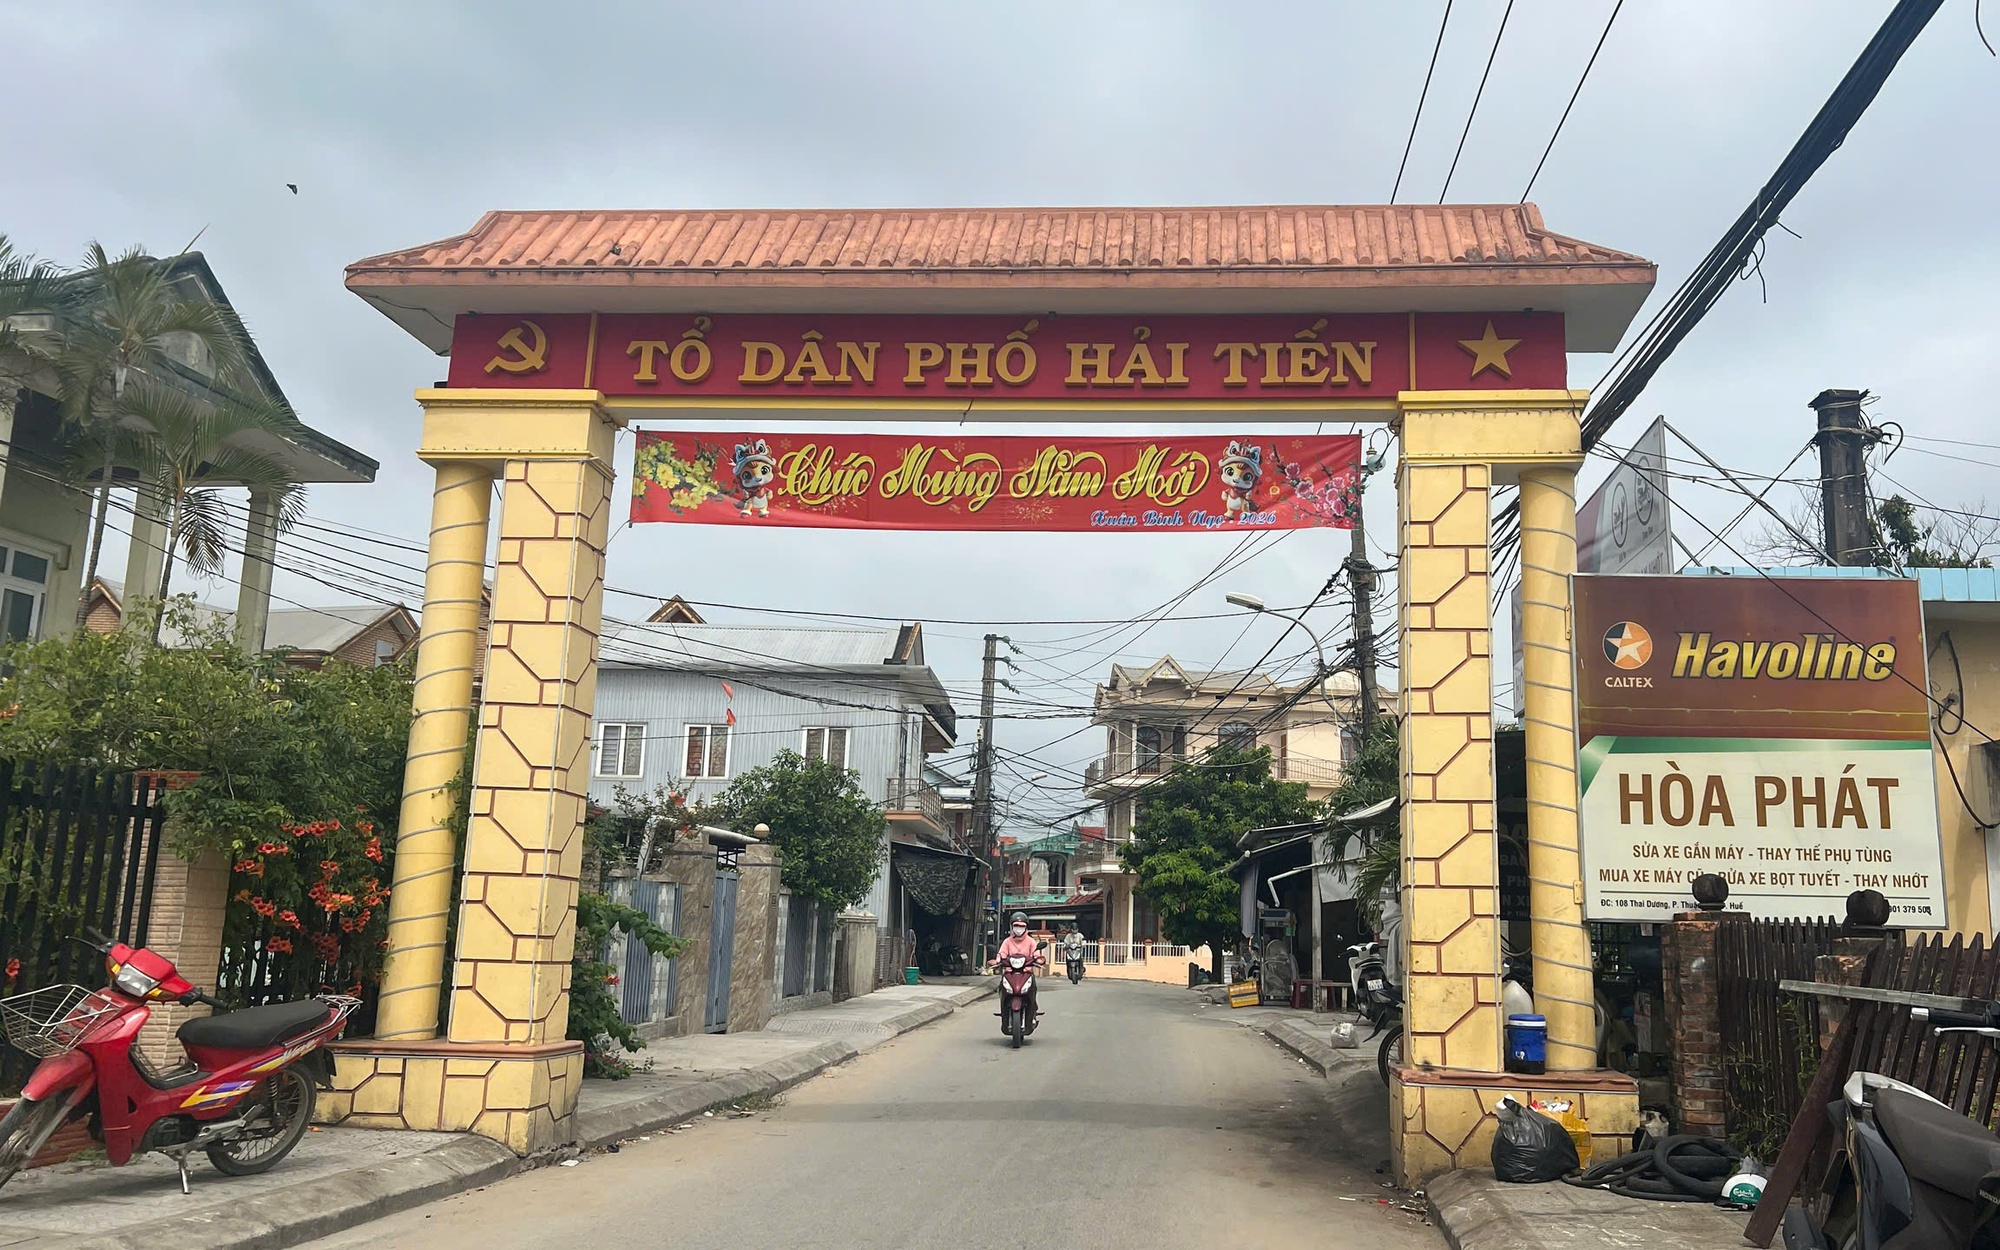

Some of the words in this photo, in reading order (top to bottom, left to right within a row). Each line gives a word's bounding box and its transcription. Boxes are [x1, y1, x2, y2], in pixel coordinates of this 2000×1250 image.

[626, 316, 711, 383] TỔ
[738, 330, 881, 384] DÂN
[903, 319, 1038, 386] PHỐ
[1064, 326, 1190, 387] HẢI
[1213, 318, 1377, 387] TIẾN
[778, 443, 876, 505] Chúc
[880, 443, 1002, 512] Mừng
[1009, 444, 1107, 499] Năm
[1112, 444, 1210, 507] Mới
[1090, 510, 1138, 526] Xuân
[1237, 510, 1276, 525] 2026
[1672, 632, 1897, 682] Havoline
[1604, 675, 1654, 689] CALTEX
[1618, 760, 1735, 828] HÒA
[1754, 763, 1900, 830] PHÁT
[1633, 841, 1660, 858] SỬA
[1663, 845, 1680, 859] XE
[1715, 843, 1744, 860] MÁY
[1757, 847, 1791, 861] THAY
[1795, 843, 1821, 862] THẾ
[1825, 848, 1852, 865] PHỤ
[1855, 846, 1892, 863] TÙNG
[1599, 868, 1629, 882] MUA
[1633, 870, 1650, 883] XE
[1654, 867, 1683, 884] MÁY
[1749, 871, 1766, 885] XE
[1770, 872, 1795, 888] BỌT
[1799, 868, 1841, 887] TUYẾT
[1853, 874, 1888, 888] THAY
[1892, 871, 1929, 889] NHỚT
[1615, 899, 1628, 908] 108
